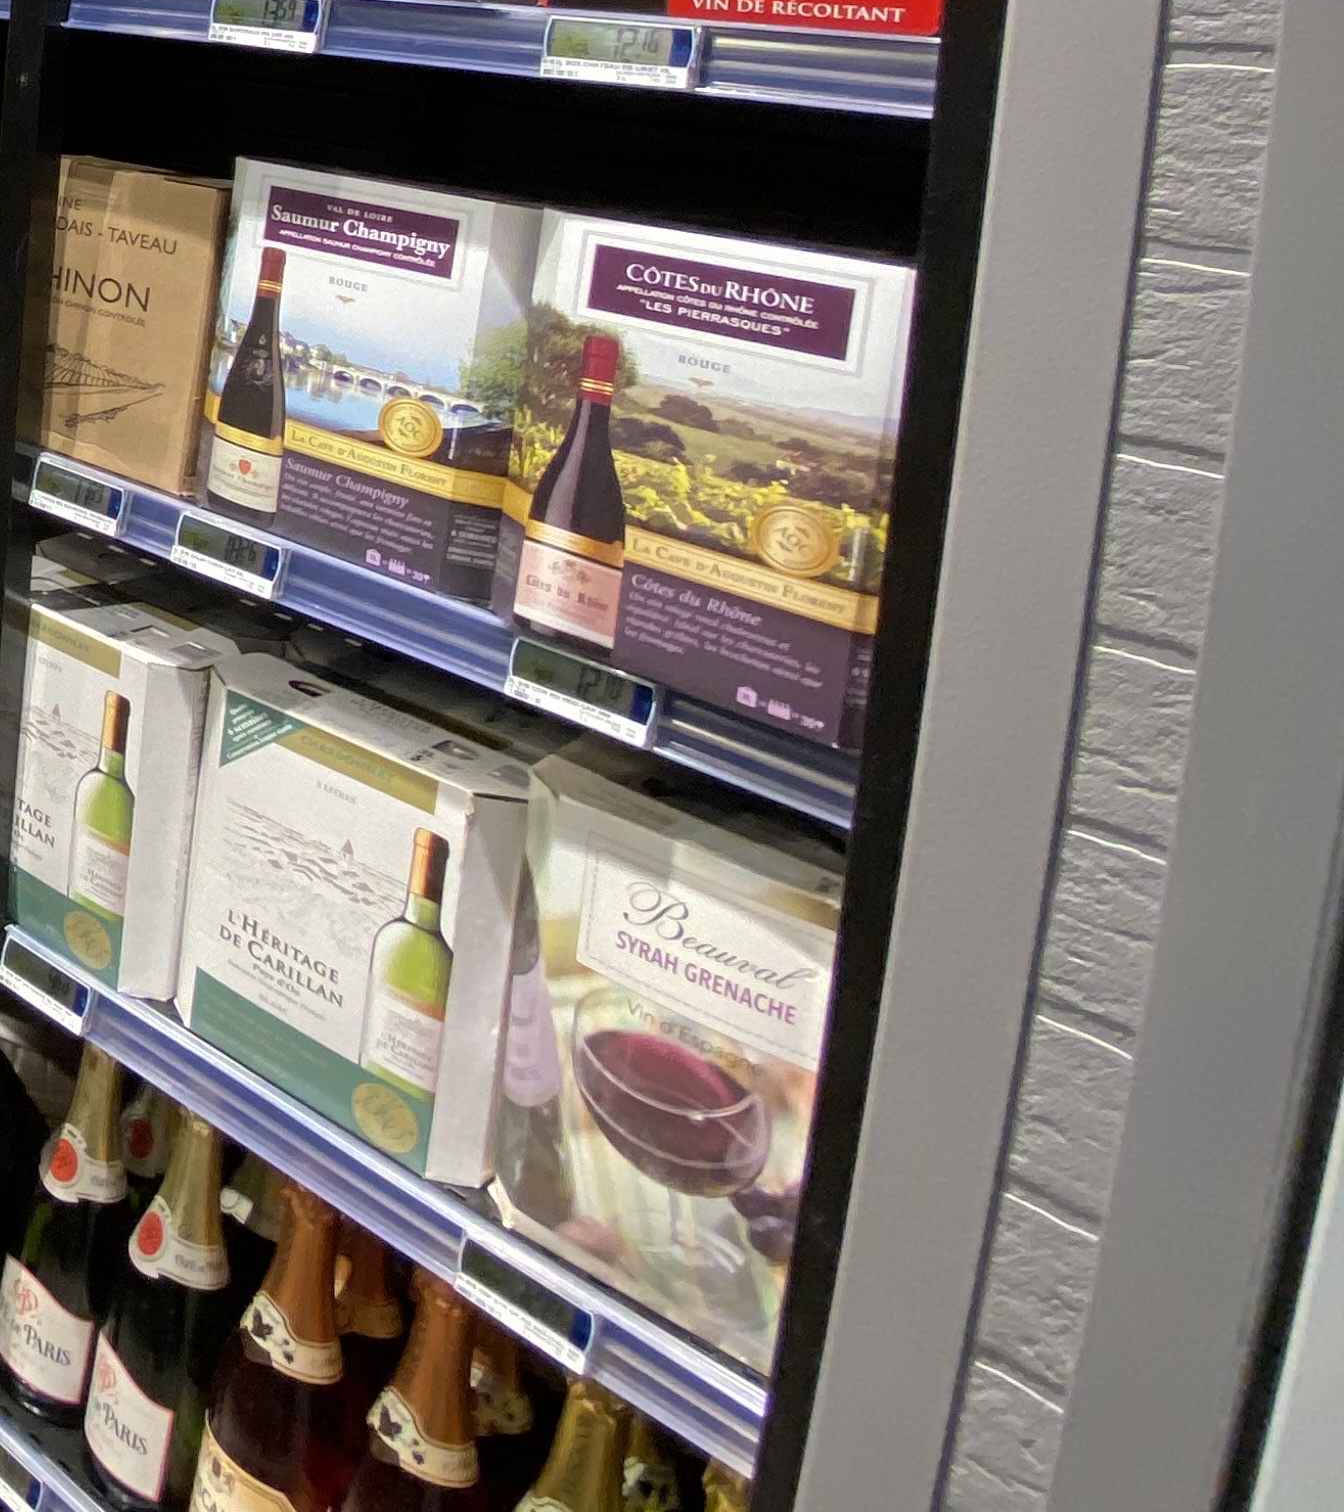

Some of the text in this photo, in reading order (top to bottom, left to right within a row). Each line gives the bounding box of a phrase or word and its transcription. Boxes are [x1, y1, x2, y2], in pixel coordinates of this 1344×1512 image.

[736, 0, 765, 13] DE
[108, 227, 177, 255] TAVEAU
[271, 204, 451, 259] Saumur Champigny
[328, 276, 368, 292] ROUGE
[626, 263, 700, 292] CÔTES
[724, 281, 816, 314] RHÔNE
[678, 354, 732, 374] ROUGE
[286, 457, 409, 509] Saumur Champigny
[632, 574, 763, 627] Côtes du Rhône
[623, 881, 820, 989] Beauval
[219, 924, 242, 948] DE
[247, 940, 344, 1008] CARILLAN
[616, 930, 797, 1026] SYRAH GRENACHE
[627, 998, 655, 1026] Vin
[23, 1324, 72, 1366] PARIS
[103, 1402, 149, 1455] PARIS
